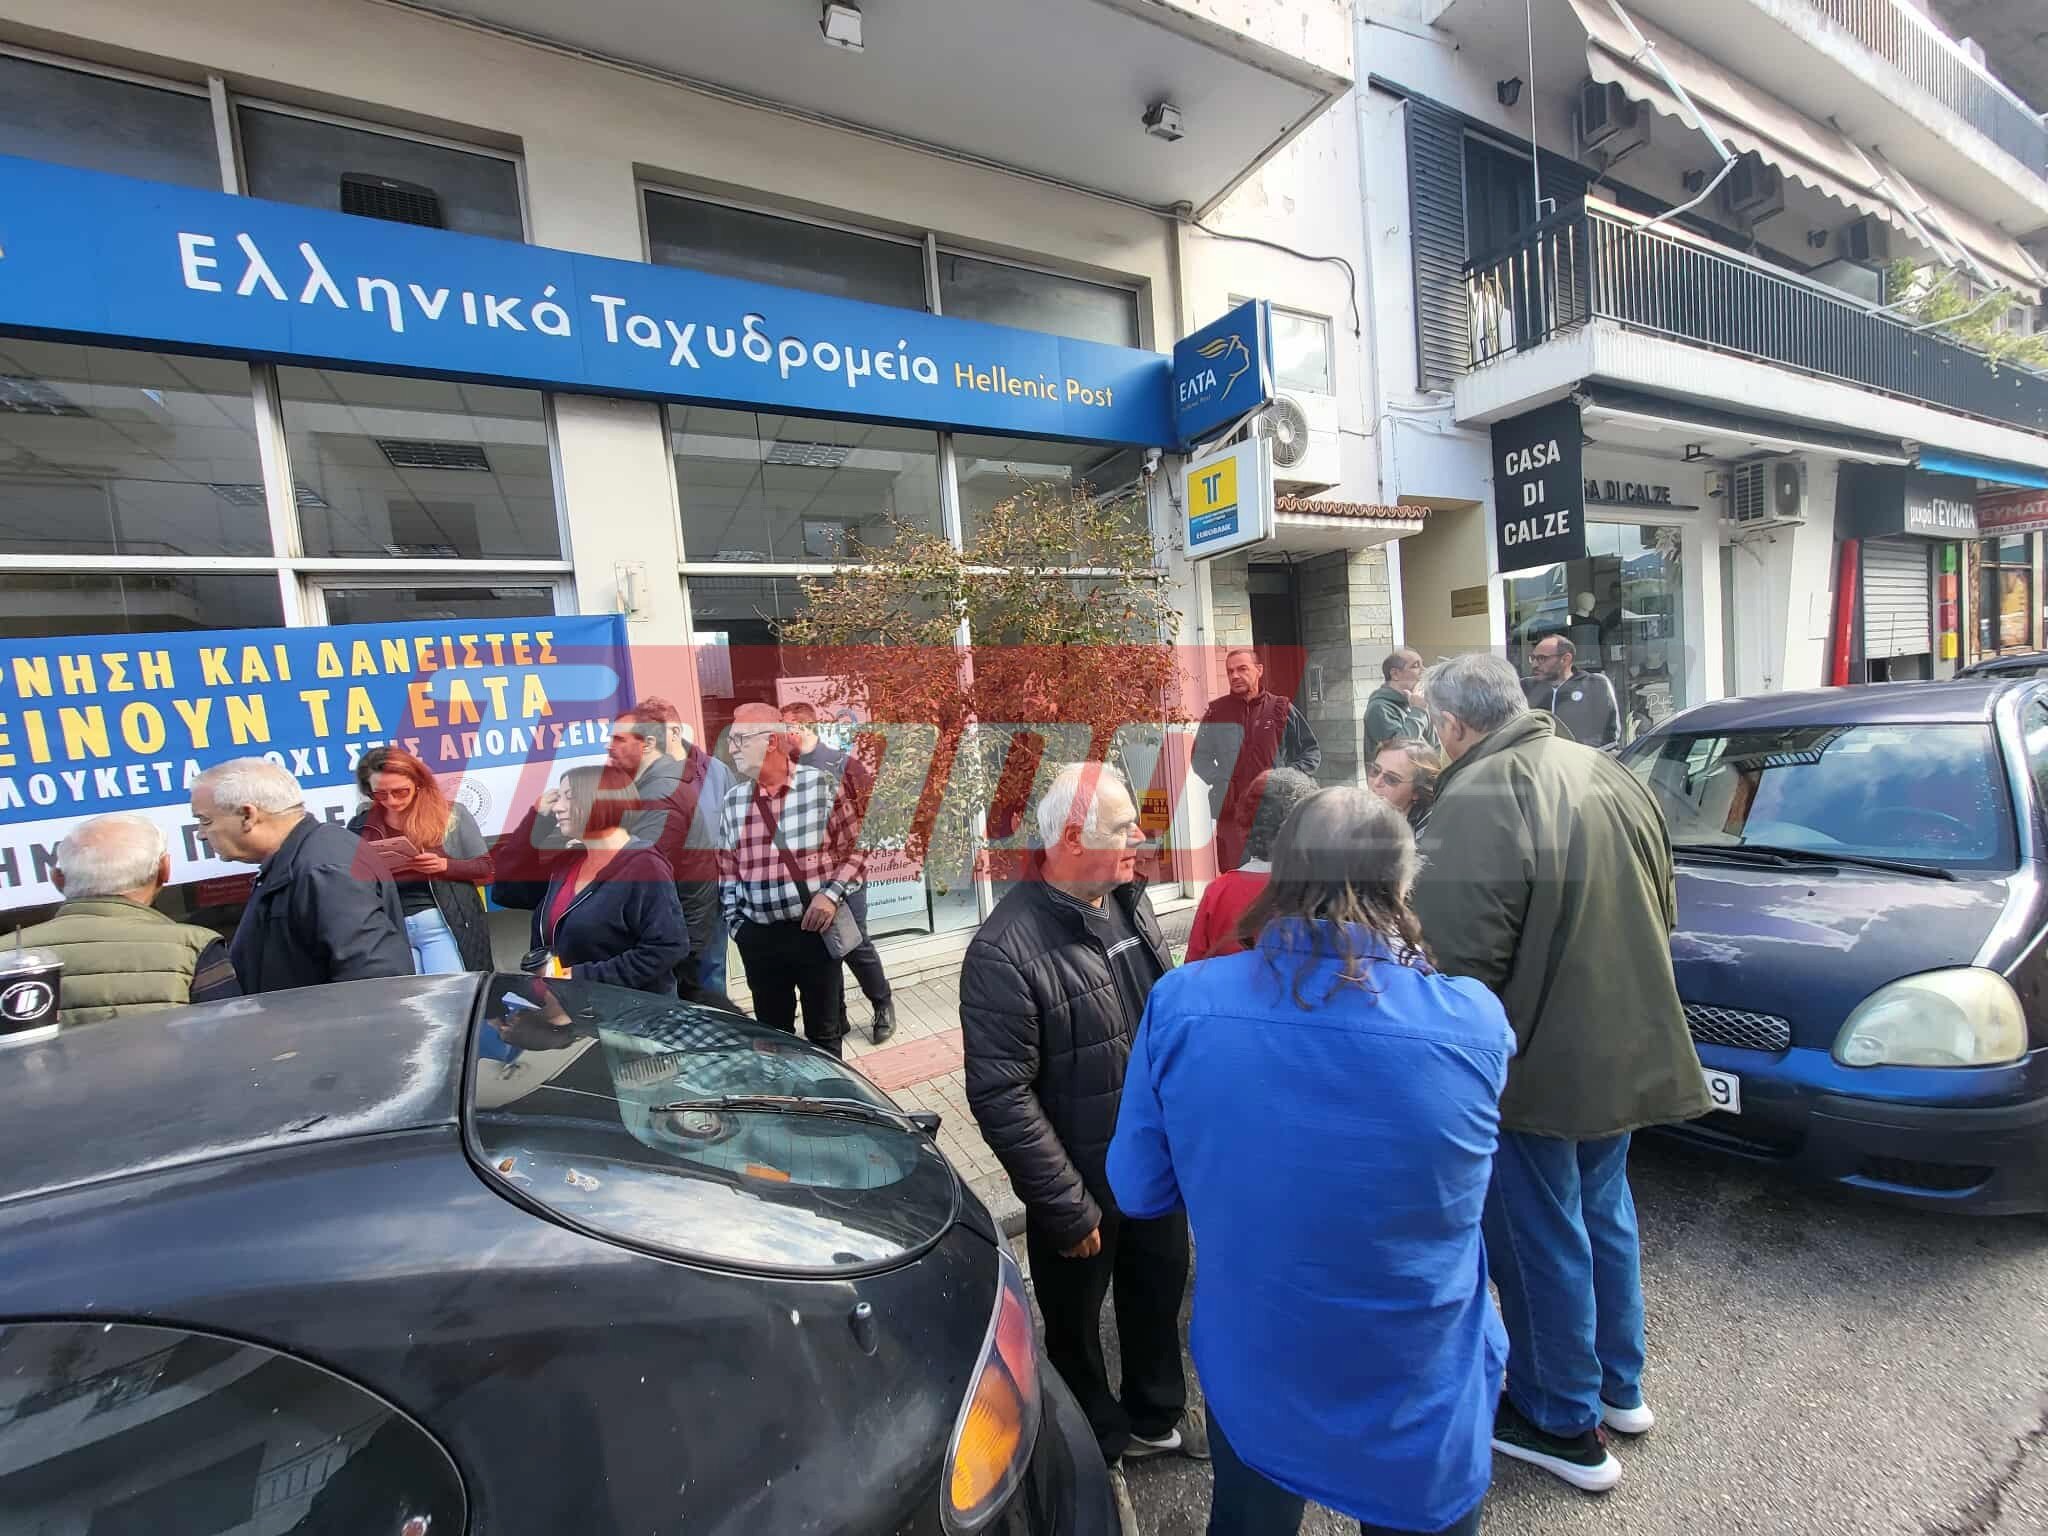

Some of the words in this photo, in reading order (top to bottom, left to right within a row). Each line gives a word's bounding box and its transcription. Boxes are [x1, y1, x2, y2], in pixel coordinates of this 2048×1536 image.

[177, 232, 572, 336] Ελληνικά
[591, 294, 939, 388] Ταχυδρομεία
[954, 362, 1058, 400] Hellenic
[1066, 378, 1113, 407] Post
[1180, 369, 1217, 402] ΕΛΤΑ
[1505, 439, 1561, 476] CASA
[1523, 480, 1545, 507] DI
[1606, 479, 1620, 502] DI
[1624, 482, 1671, 504] CALZE
[1504, 510, 1570, 546] CALZE
[0, 650, 175, 698] ΝΗΣΗ
[199, 644, 292, 687] ΚΑΙ
[316, 631, 559, 679] ΔΑΝΕΙΣΤΕΣ
[299, 686, 382, 738] ΤΑ
[408, 674, 553, 729] ΕΛΤΑ
[440, 718, 611, 762] ΑΠΟΛΥΣΕΙΣ
